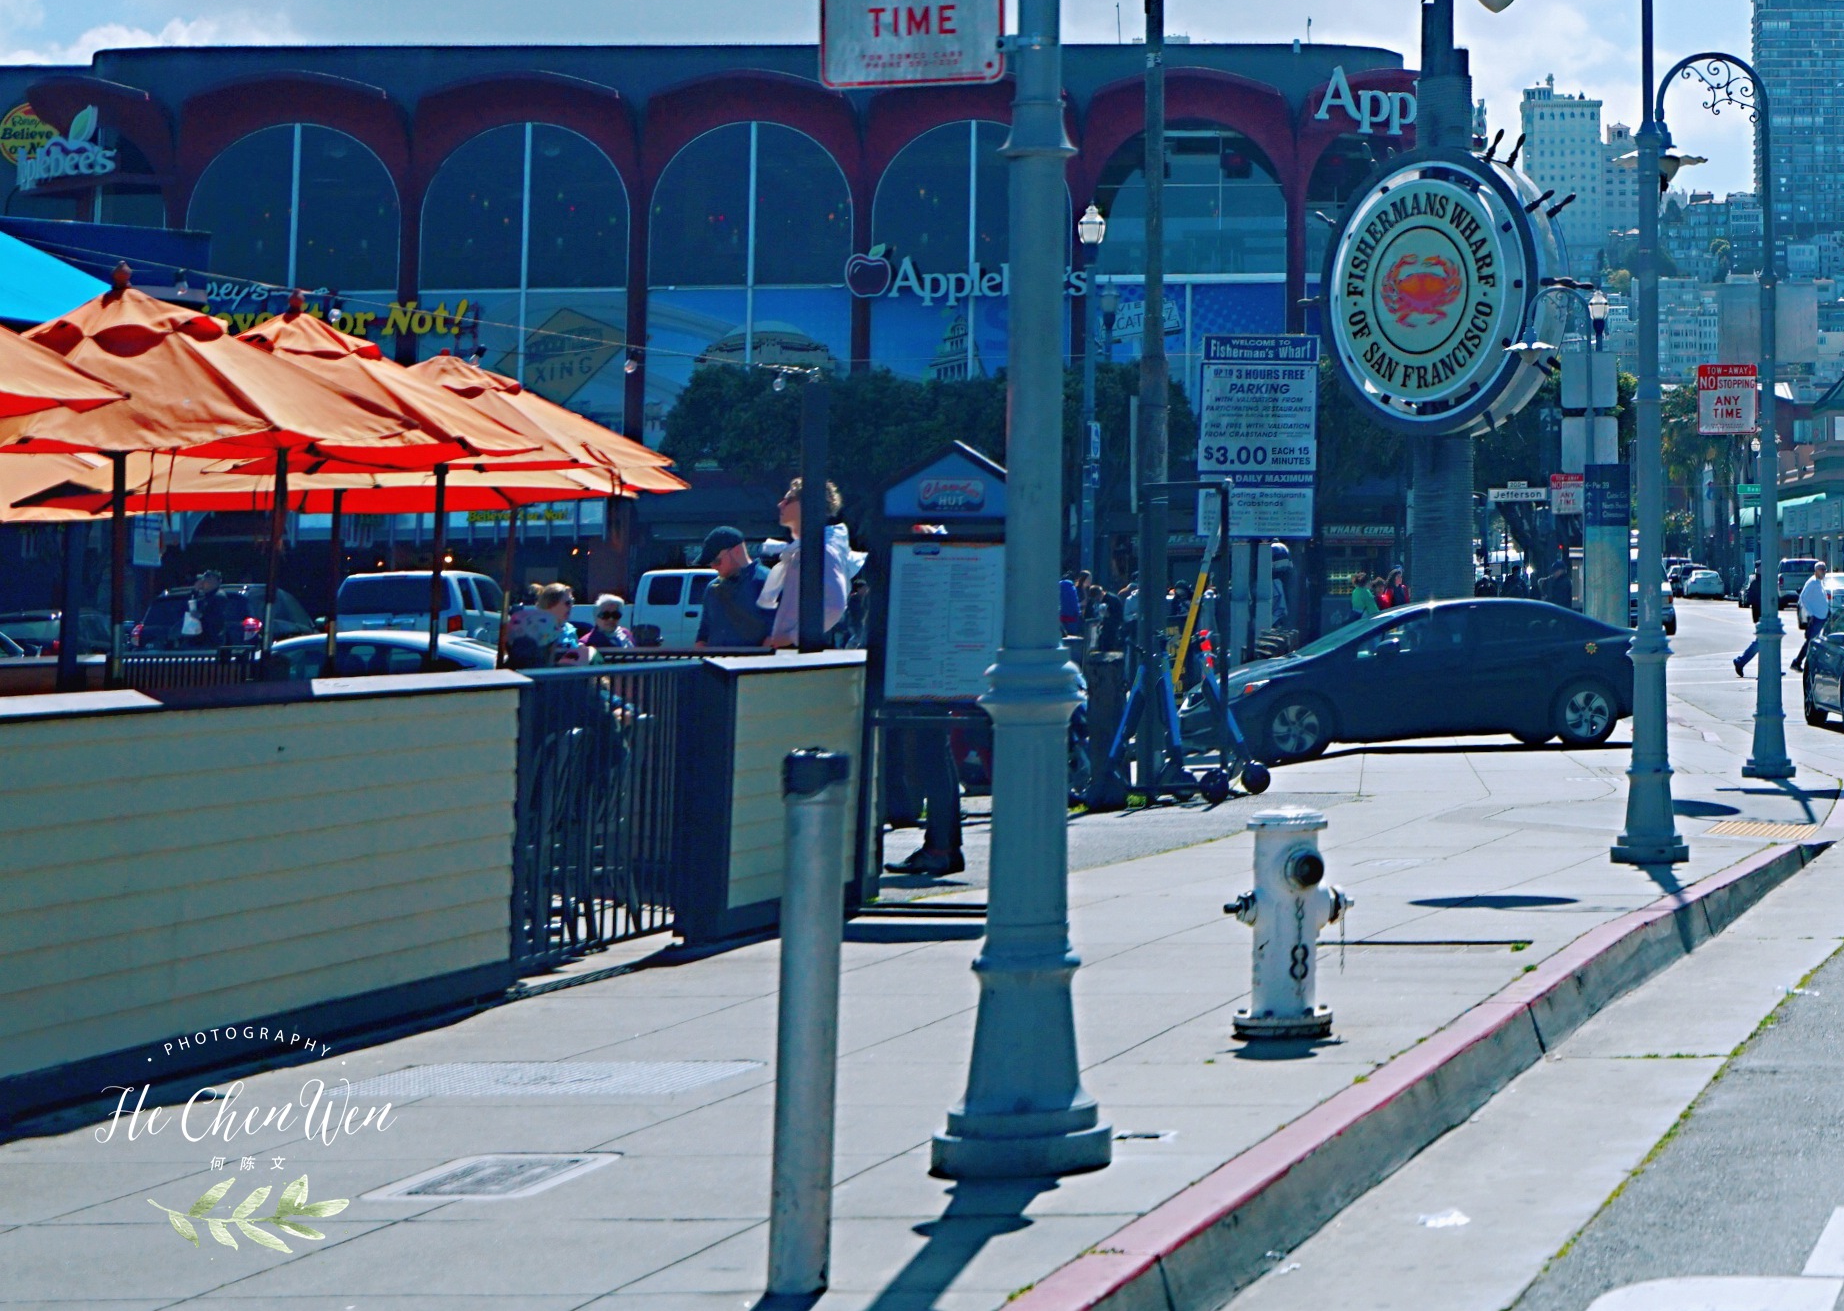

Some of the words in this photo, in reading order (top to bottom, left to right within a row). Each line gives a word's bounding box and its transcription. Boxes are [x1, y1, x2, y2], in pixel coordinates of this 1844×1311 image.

[868, 5, 957, 37] TIME
[1314, 65, 1418, 135] App
[1346, 191, 1450, 298] FISHERMANS
[1449, 202, 1496, 289] WHARF
[888, 255, 1088, 307] Apple's
[381, 298, 470, 336] Not!
[1210, 339, 1275, 358] Fisherman's
[1279, 340, 1312, 359] Wharf
[1231, 339, 1276, 347] WELCOME
[1348, 309, 1371, 340] OF
[1363, 342, 1399, 383] SAN
[1401, 300, 1494, 389] FRANCISCO
[533, 356, 593, 385] XING
[1236, 369, 1243, 380] 3
[1245, 369, 1280, 380] HOURS
[1282, 369, 1306, 380] FREE
[1228, 383, 1291, 395] PARKING
[1700, 376, 1716, 389] NO
[1718, 379, 1755, 389] STOPPING
[1714, 395, 1741, 406] ANY
[1713, 408, 1743, 419] TIME
[1203, 445, 1268, 465] $3.00
[1271, 447, 1295, 455] EACH
[1298, 446, 1310, 455] 15
[1271, 457, 1311, 465] MINUTES
[1235, 474, 1263, 483] DAILY
[1264, 474, 1313, 483] MAXIMUM
[938, 495, 965, 506] HUT
[1494, 490, 1542, 499] Jefferson
[1289, 943, 1310, 981] 8
